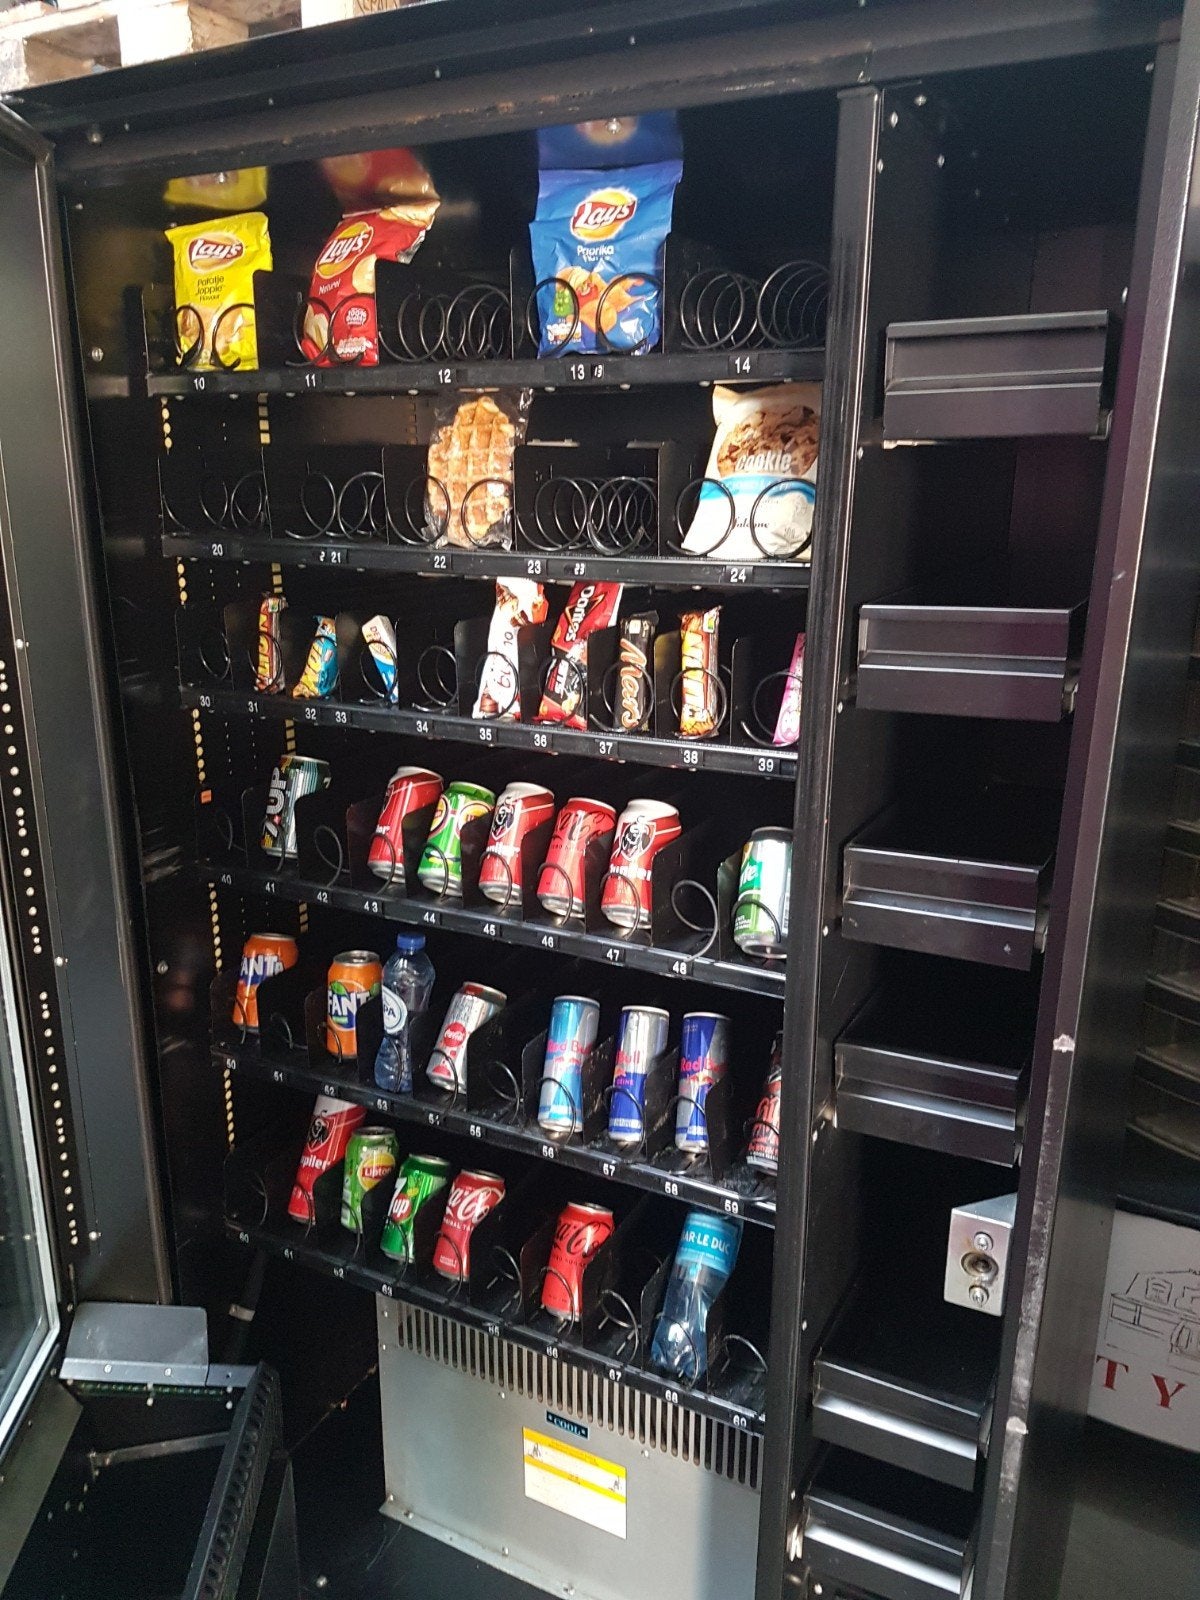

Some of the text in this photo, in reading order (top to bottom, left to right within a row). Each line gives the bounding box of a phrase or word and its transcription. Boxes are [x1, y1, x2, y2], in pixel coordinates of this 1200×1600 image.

[574, 201, 631, 230] Lay's
[734, 356, 751, 374] 14
[438, 369, 452, 384] 12
[570, 364, 586, 380] 13
[193, 378, 206, 391] 10
[305, 374, 317, 388] 11
[211, 544, 224, 556] 20
[331, 551, 342, 563] 21
[434, 555, 447, 569] 22
[527, 560, 541, 575] 23
[730, 567, 747, 583] 24
[200, 696, 211, 708] 30
[248, 702, 258, 713] 31
[305, 708, 317, 721] 32
[335, 712, 347, 724] 33
[416, 720, 429, 733] 34
[479, 728, 492, 742] 35
[534, 733, 547, 748] 36
[600, 742, 613, 756] 37
[684, 750, 699, 765] 38
[758, 758, 774, 772] 39
[265, 882, 275, 893] 41
[316, 892, 328, 903] 42
[363, 902, 379, 913] 43
[423, 911, 436, 924] 44
[541, 936, 554, 948] 46
[606, 949, 620, 962] 47
[672, 961, 687, 975] 48
[603, 1164, 616, 1177] 57
[665, 1182, 678, 1196] 58
[725, 1199, 739, 1213] 59
[609, 1371, 622, 1383] 67
[665, 1390, 678, 1403] 68
